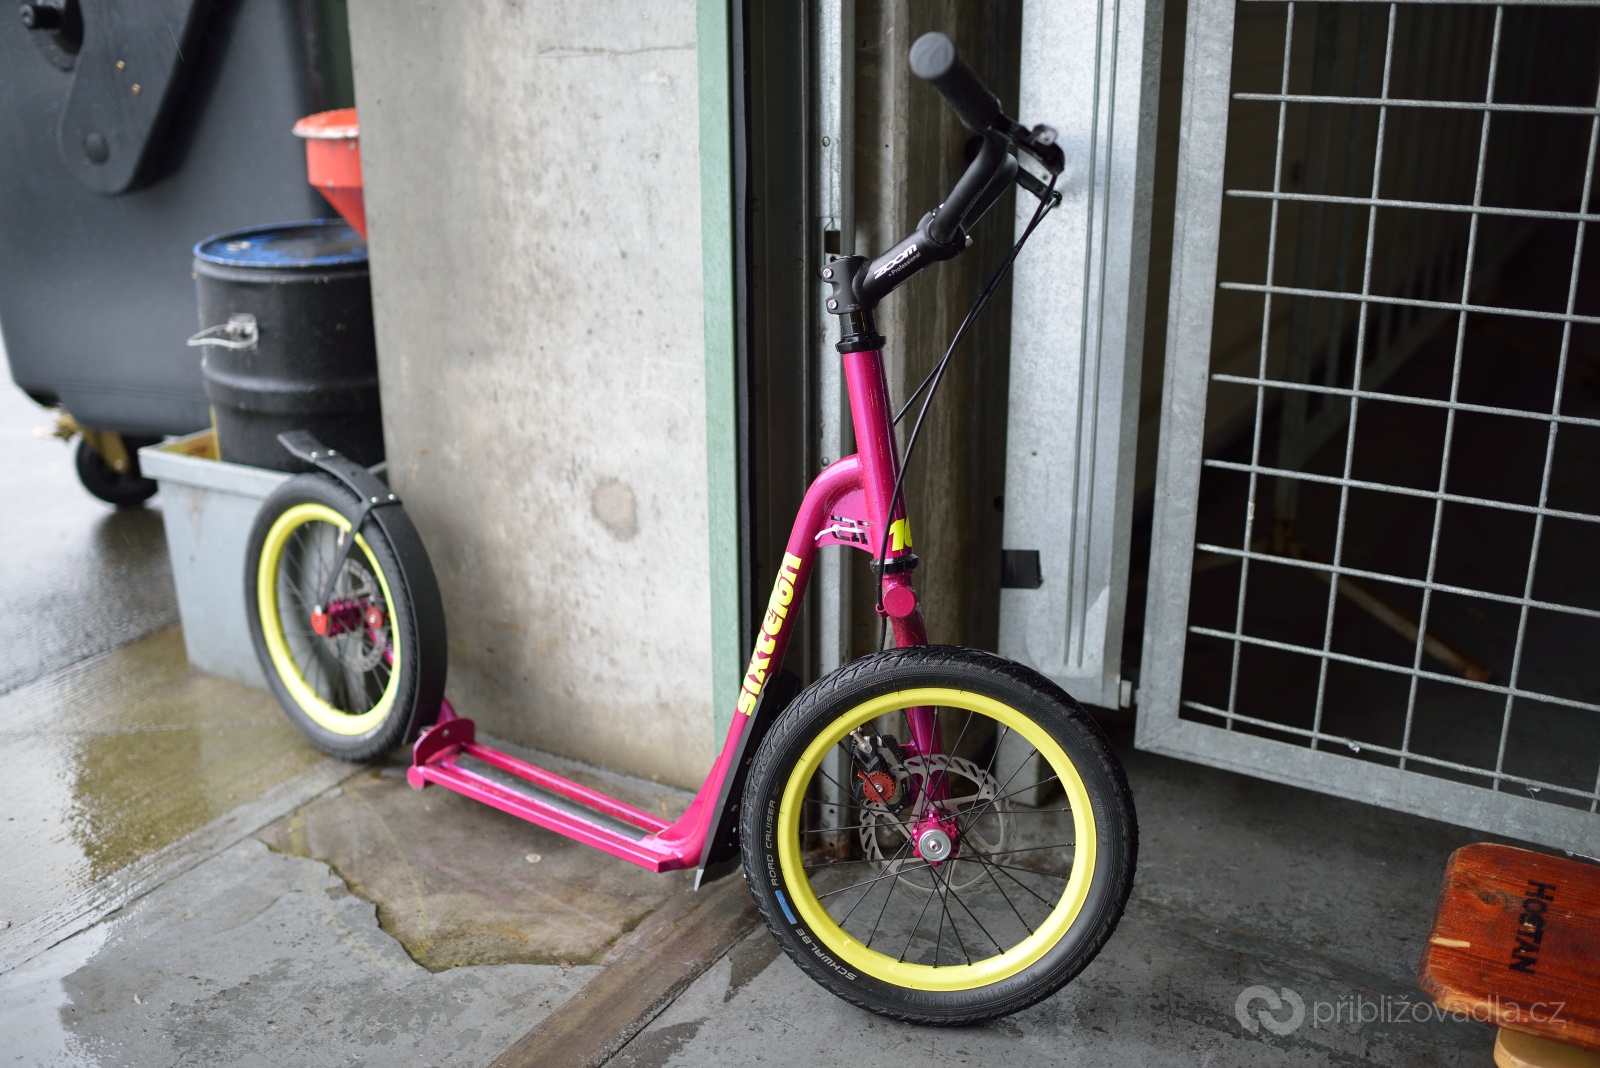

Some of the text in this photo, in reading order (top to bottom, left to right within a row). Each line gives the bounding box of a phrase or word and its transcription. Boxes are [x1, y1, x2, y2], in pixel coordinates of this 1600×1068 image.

[891, 251, 921, 275] Professional
[765, 800, 776, 850] CRUISER
[767, 854, 778, 886] ROAD
[1508, 880, 1556, 975] HOSTAN
[795, 928, 857, 981] SCHWALBE
